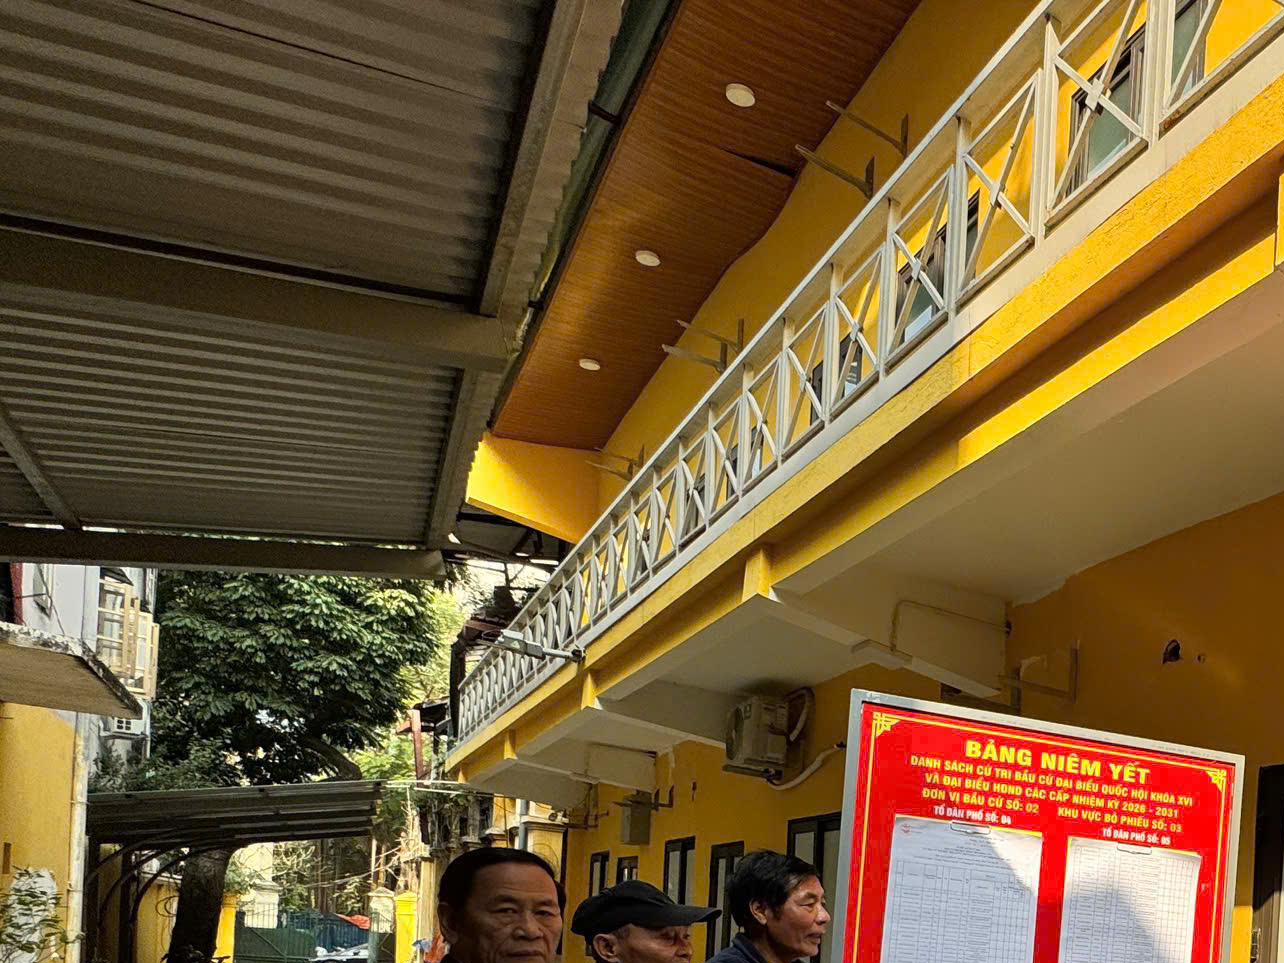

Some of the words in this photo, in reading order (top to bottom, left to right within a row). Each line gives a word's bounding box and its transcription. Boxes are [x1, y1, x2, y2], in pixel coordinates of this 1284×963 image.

[965, 738, 1033, 767] BẢNG
[1040, 751, 1102, 777] NIÊM
[1109, 761, 1151, 785] YẾT
